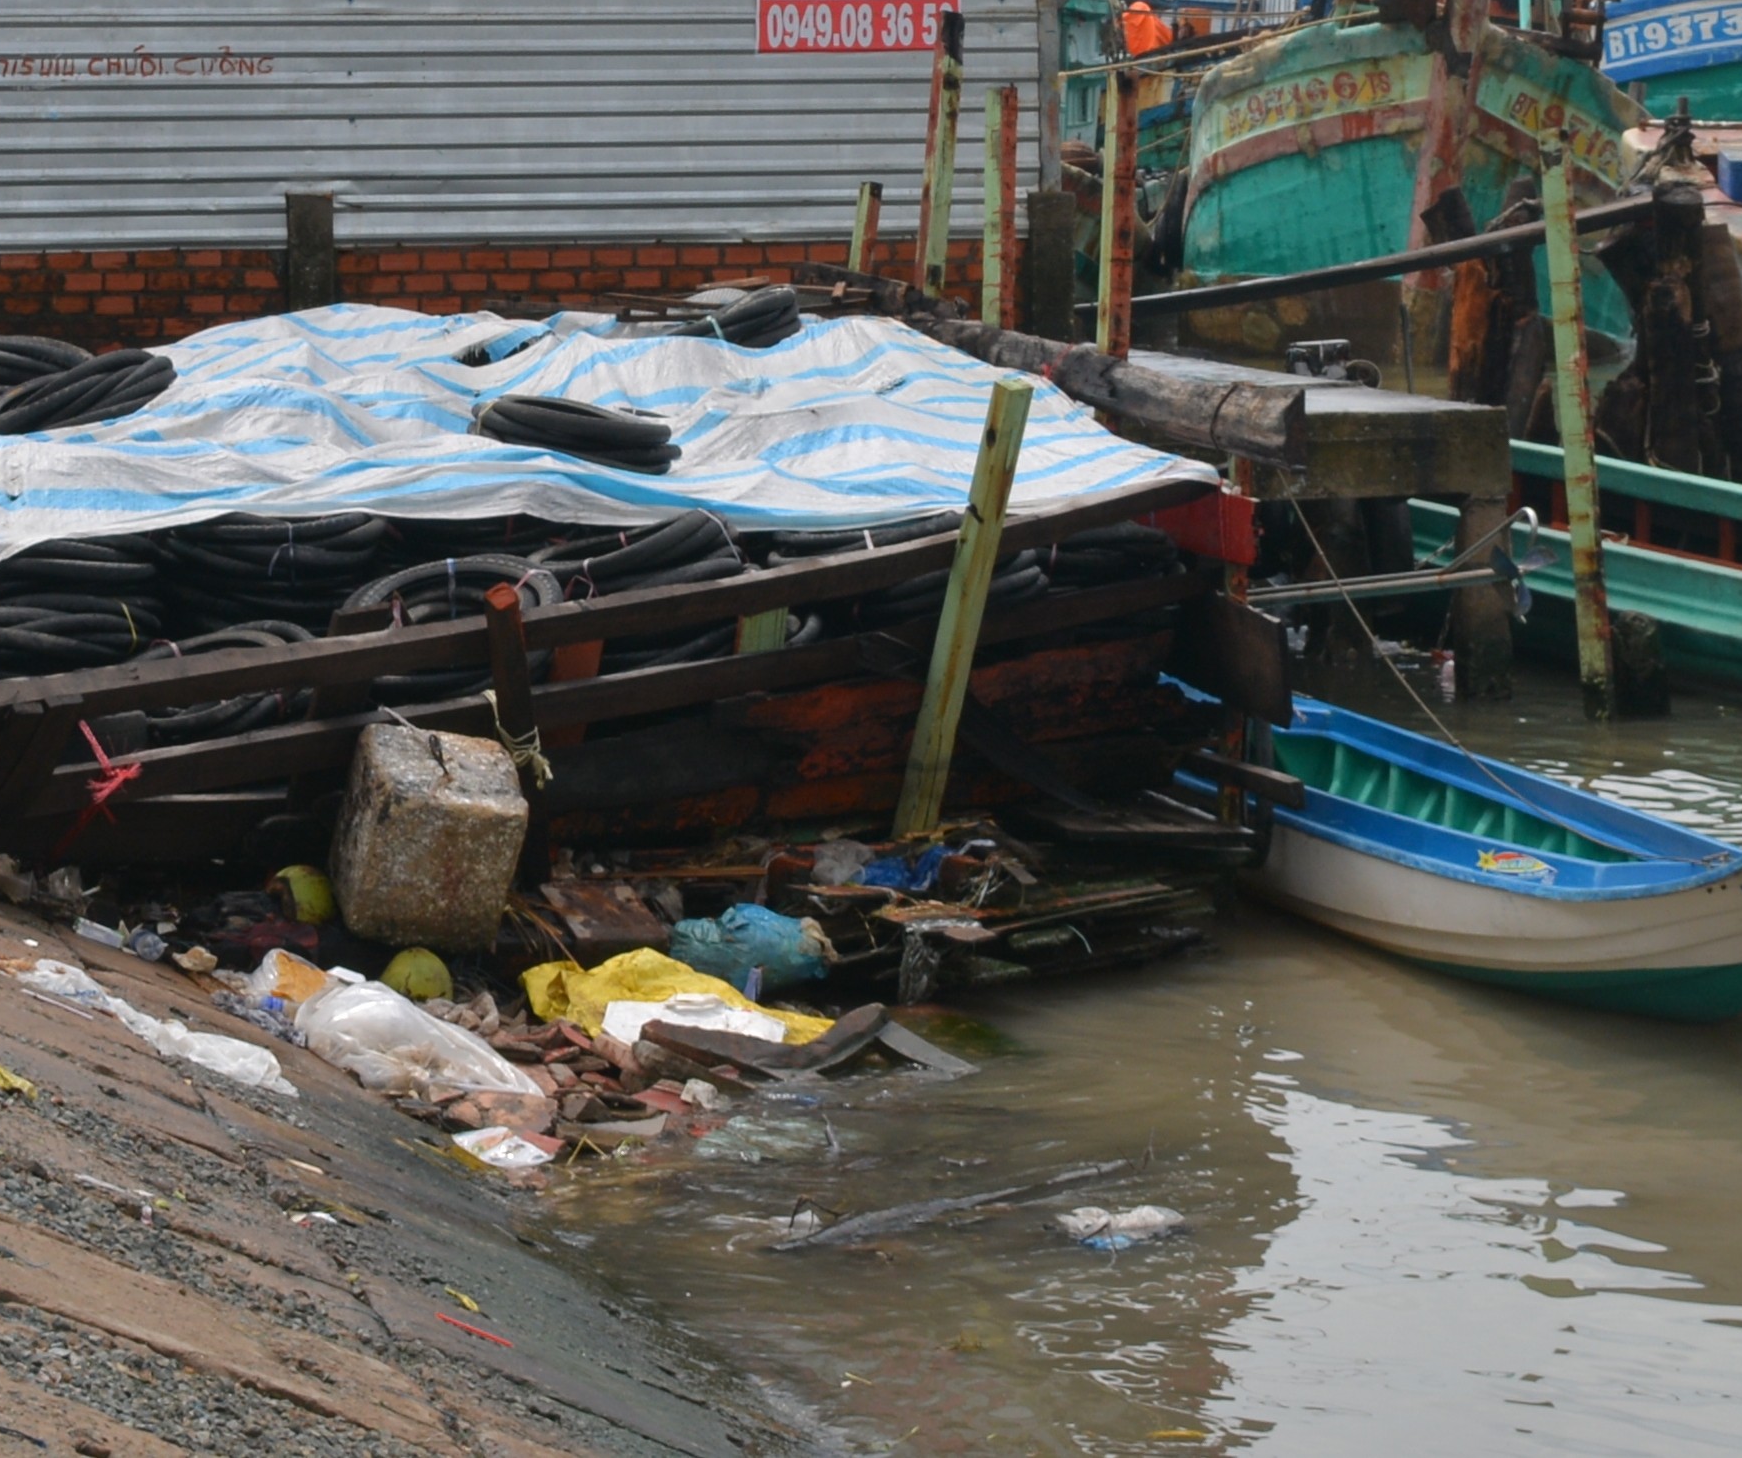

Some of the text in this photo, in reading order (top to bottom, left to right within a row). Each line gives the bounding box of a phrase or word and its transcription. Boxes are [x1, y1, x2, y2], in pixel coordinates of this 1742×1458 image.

[767, 2, 953, 47] 0949.08 36 5
[1543, 104, 1618, 162] 9716
